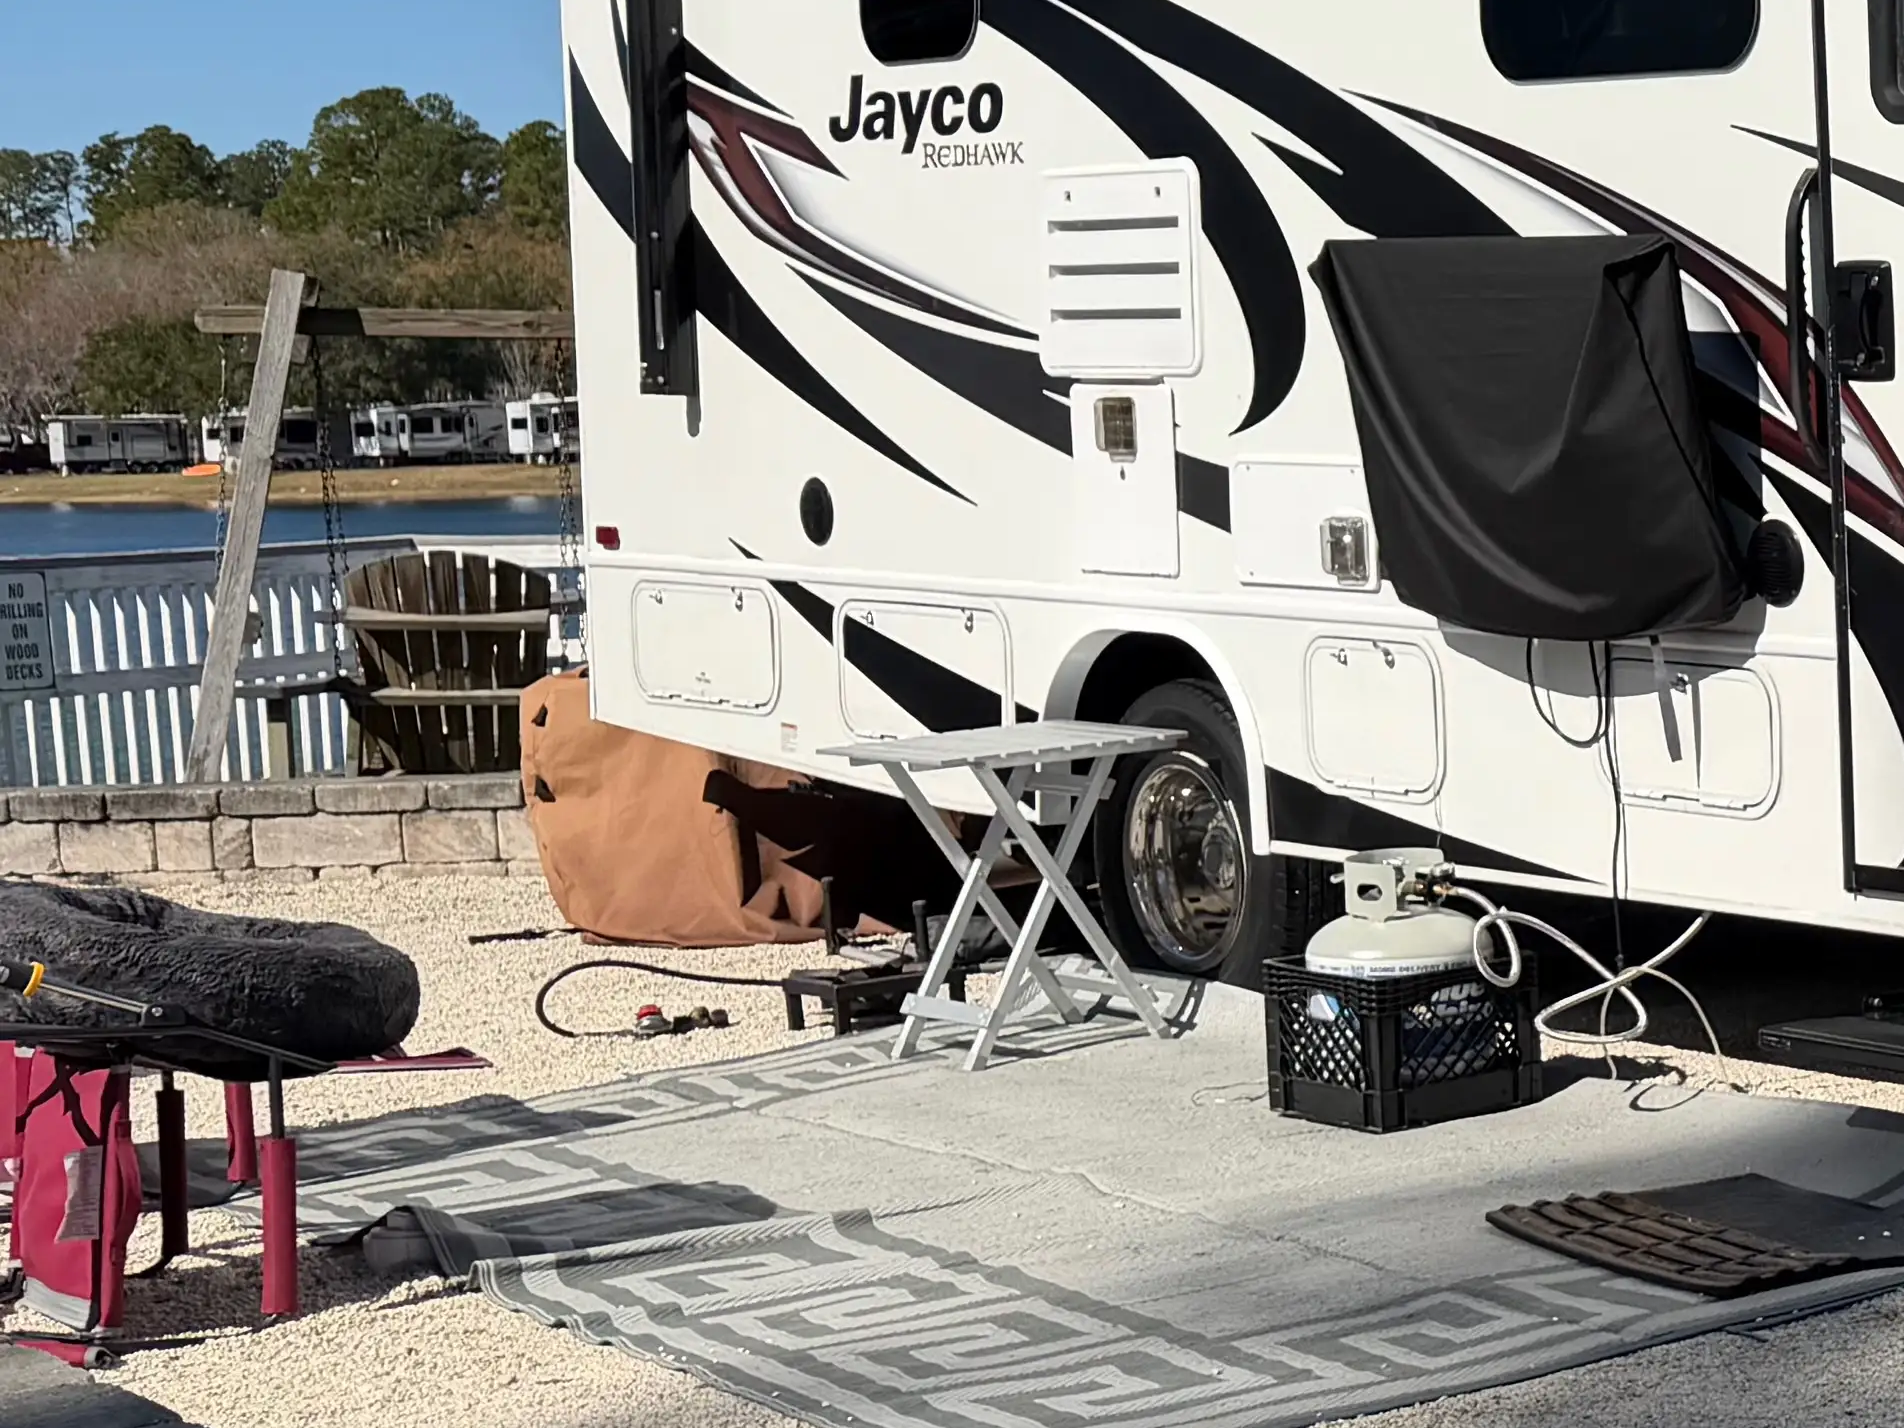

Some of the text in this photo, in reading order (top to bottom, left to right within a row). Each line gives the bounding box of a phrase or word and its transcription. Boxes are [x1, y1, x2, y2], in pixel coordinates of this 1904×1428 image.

[828, 74, 1004, 155] Jayco
[921, 141, 1025, 169] REDHAWK
[8, 582, 25, 600] NO
[0, 602, 44, 620] RILLING
[12, 622, 28, 641] ON
[4, 643, 40, 661] WOOD
[5, 663, 44, 681] DECKS
